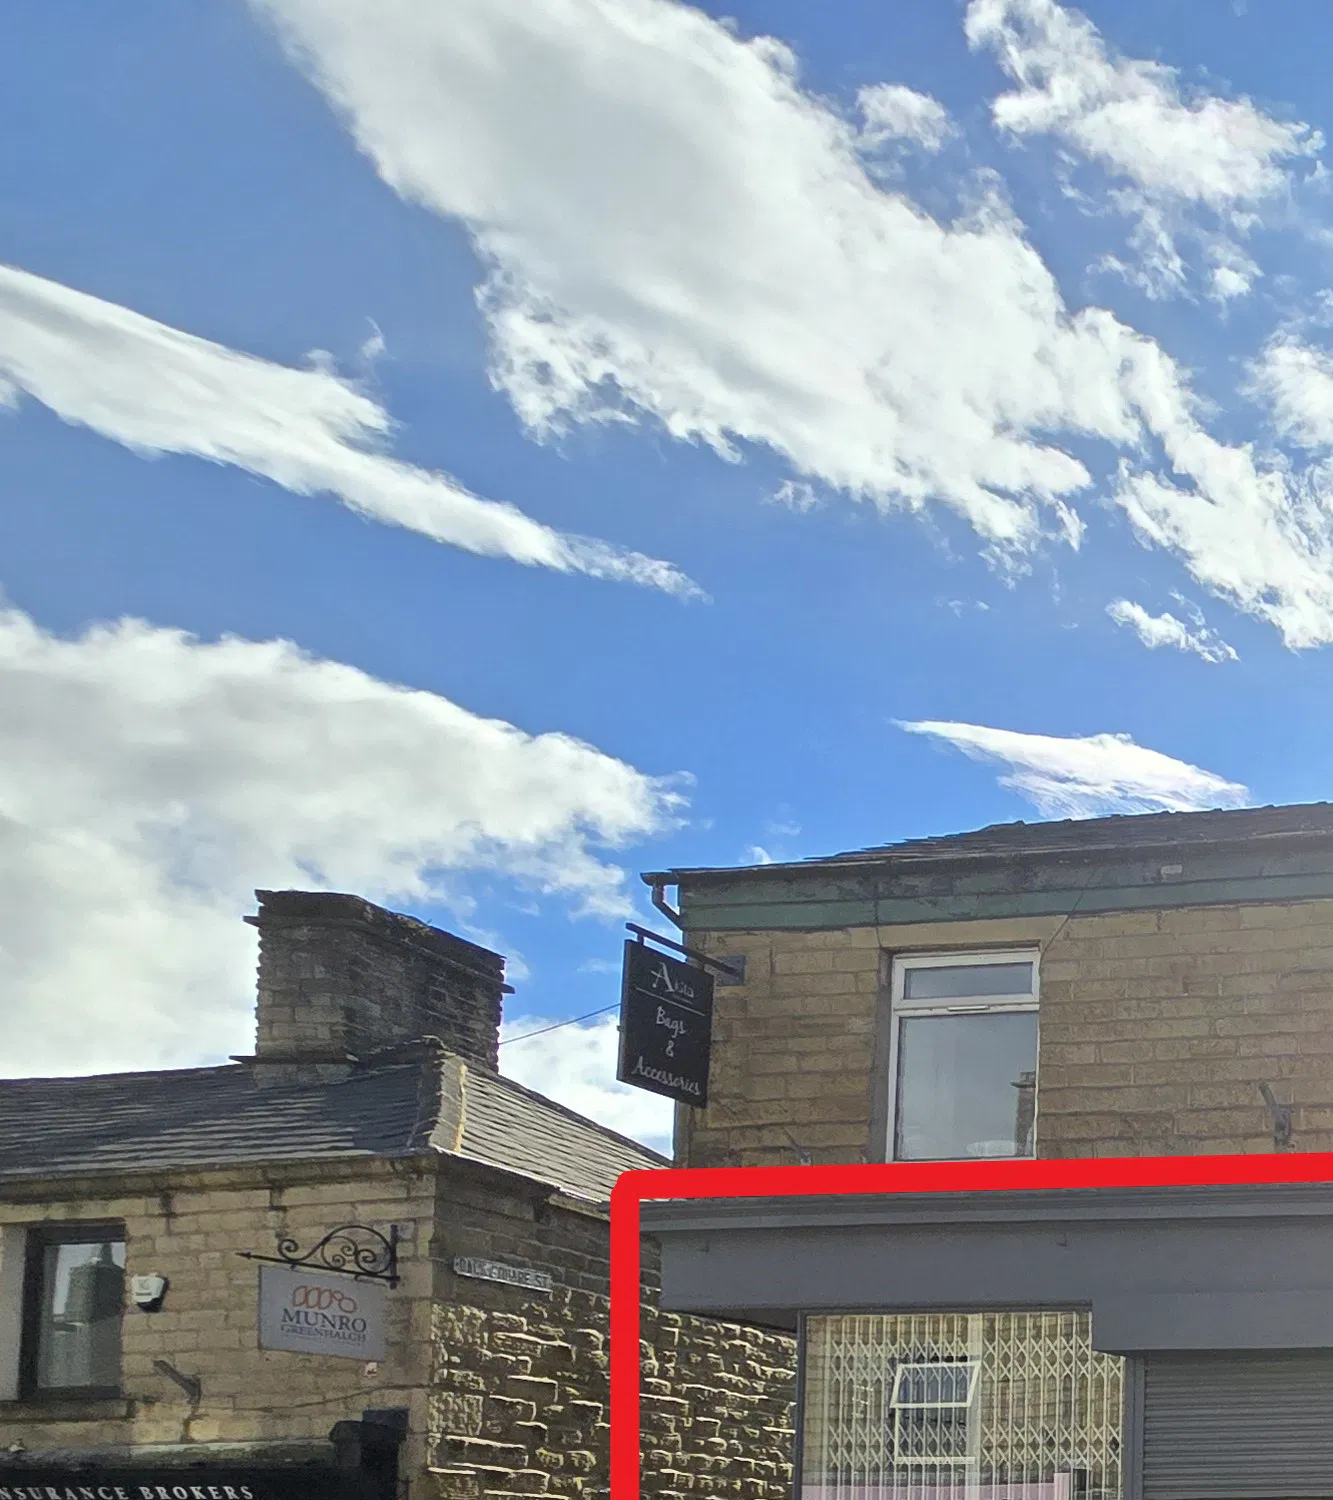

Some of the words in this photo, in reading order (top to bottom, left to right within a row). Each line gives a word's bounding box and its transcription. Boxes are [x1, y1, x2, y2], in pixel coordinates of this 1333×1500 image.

[656, 1005, 687, 1038] Bags
[665, 1040, 674, 1057] &
[631, 1055, 700, 1096] Accessories
[281, 1308, 367, 1333] MUNRO
[139, 1485, 253, 1500] BROKERS
